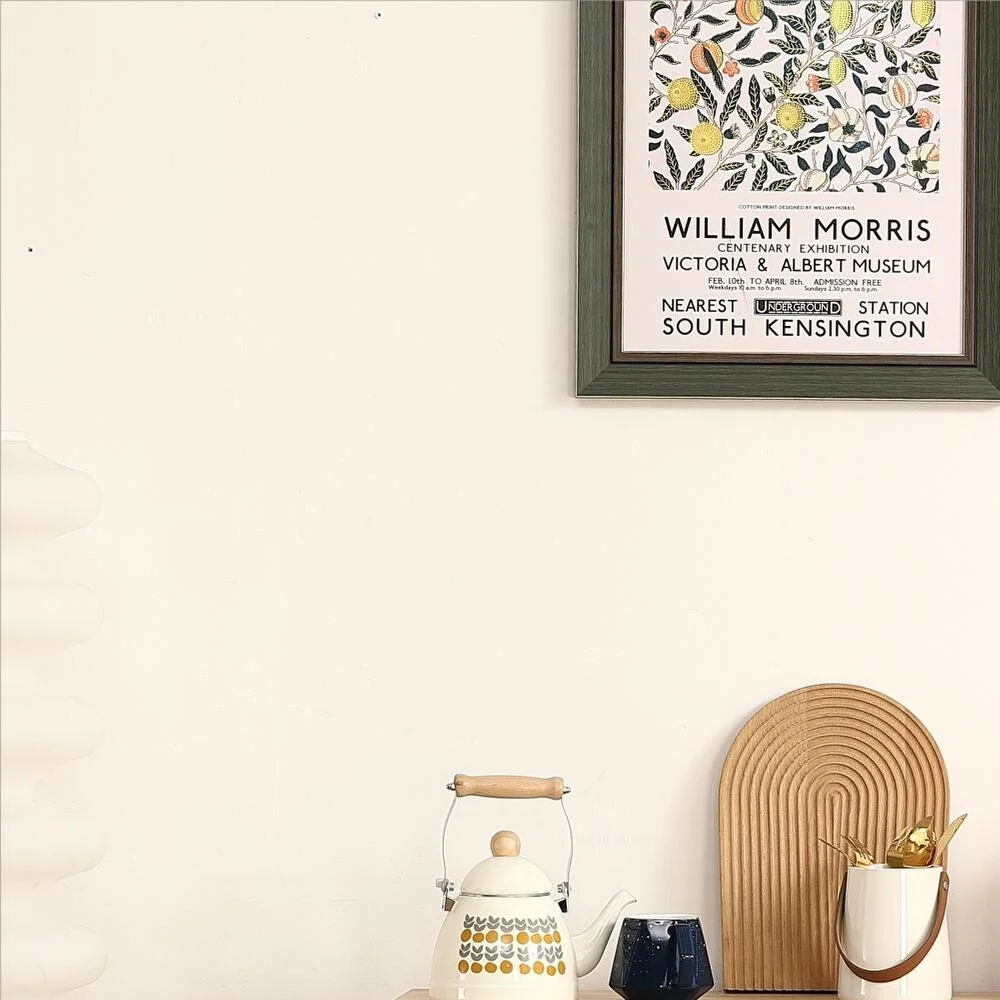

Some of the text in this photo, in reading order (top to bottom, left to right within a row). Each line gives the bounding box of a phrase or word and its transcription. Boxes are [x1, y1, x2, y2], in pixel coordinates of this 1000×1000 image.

[664, 216, 932, 242] WILLIAM MORRIS
[717, 242, 870, 254] CENTENARY EXHIBITION
[662, 256, 931, 274] VICTORIA & ALBERT MUSEUM
[707, 277, 726, 285] FEB.
[728, 277, 745, 285] 10th
[750, 277, 762, 285] TO
[764, 278, 787, 286] APRIL
[813, 278, 859, 287] ADMISSION
[861, 279, 883, 287] FREE
[662, 298, 929, 316] NEAREST UNDERGROUND STATION
[662, 317, 926, 338] SOUTH KENSINGTON
